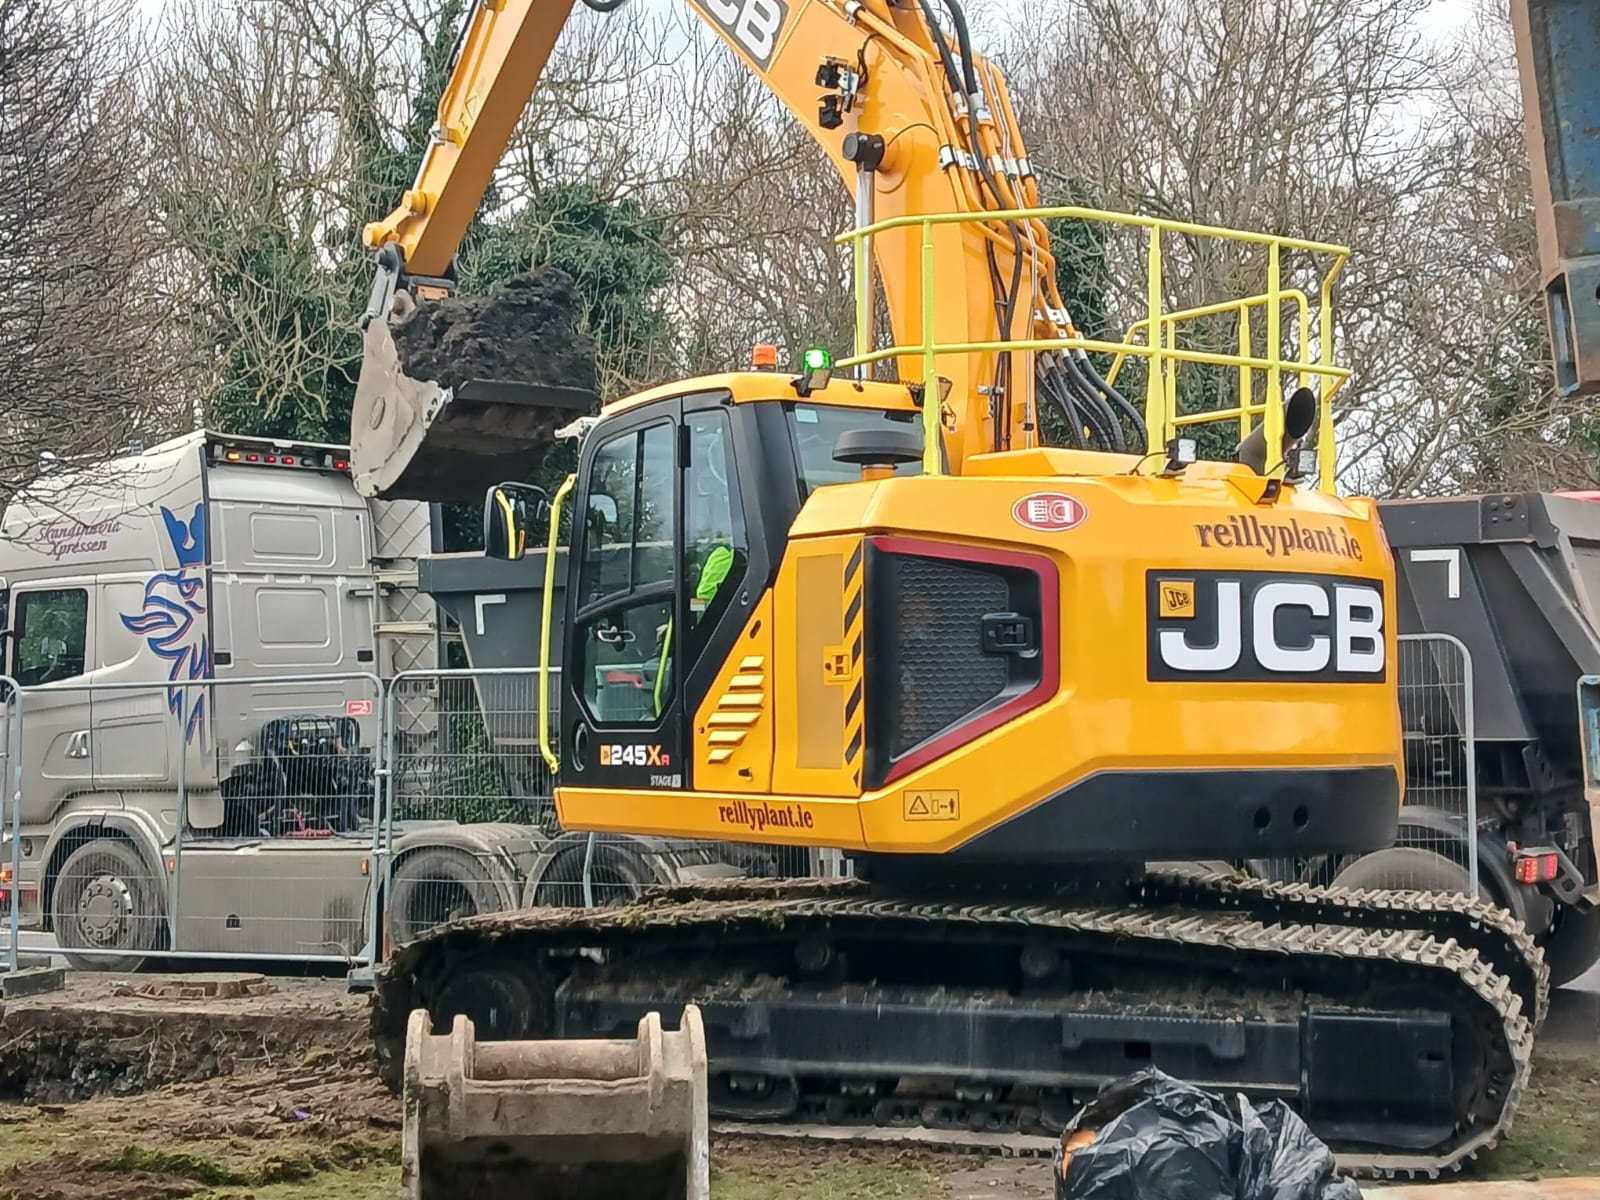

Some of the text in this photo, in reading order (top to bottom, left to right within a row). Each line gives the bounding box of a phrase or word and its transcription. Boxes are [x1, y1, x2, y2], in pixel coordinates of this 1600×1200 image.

[48, 540, 107, 560] Xpressen
[1193, 514, 1363, 562] reillyplant.ie
[1169, 590, 1190, 608] JCB
[1158, 579, 1385, 673] JCB
[718, 799, 814, 831] reillyplant.ie
